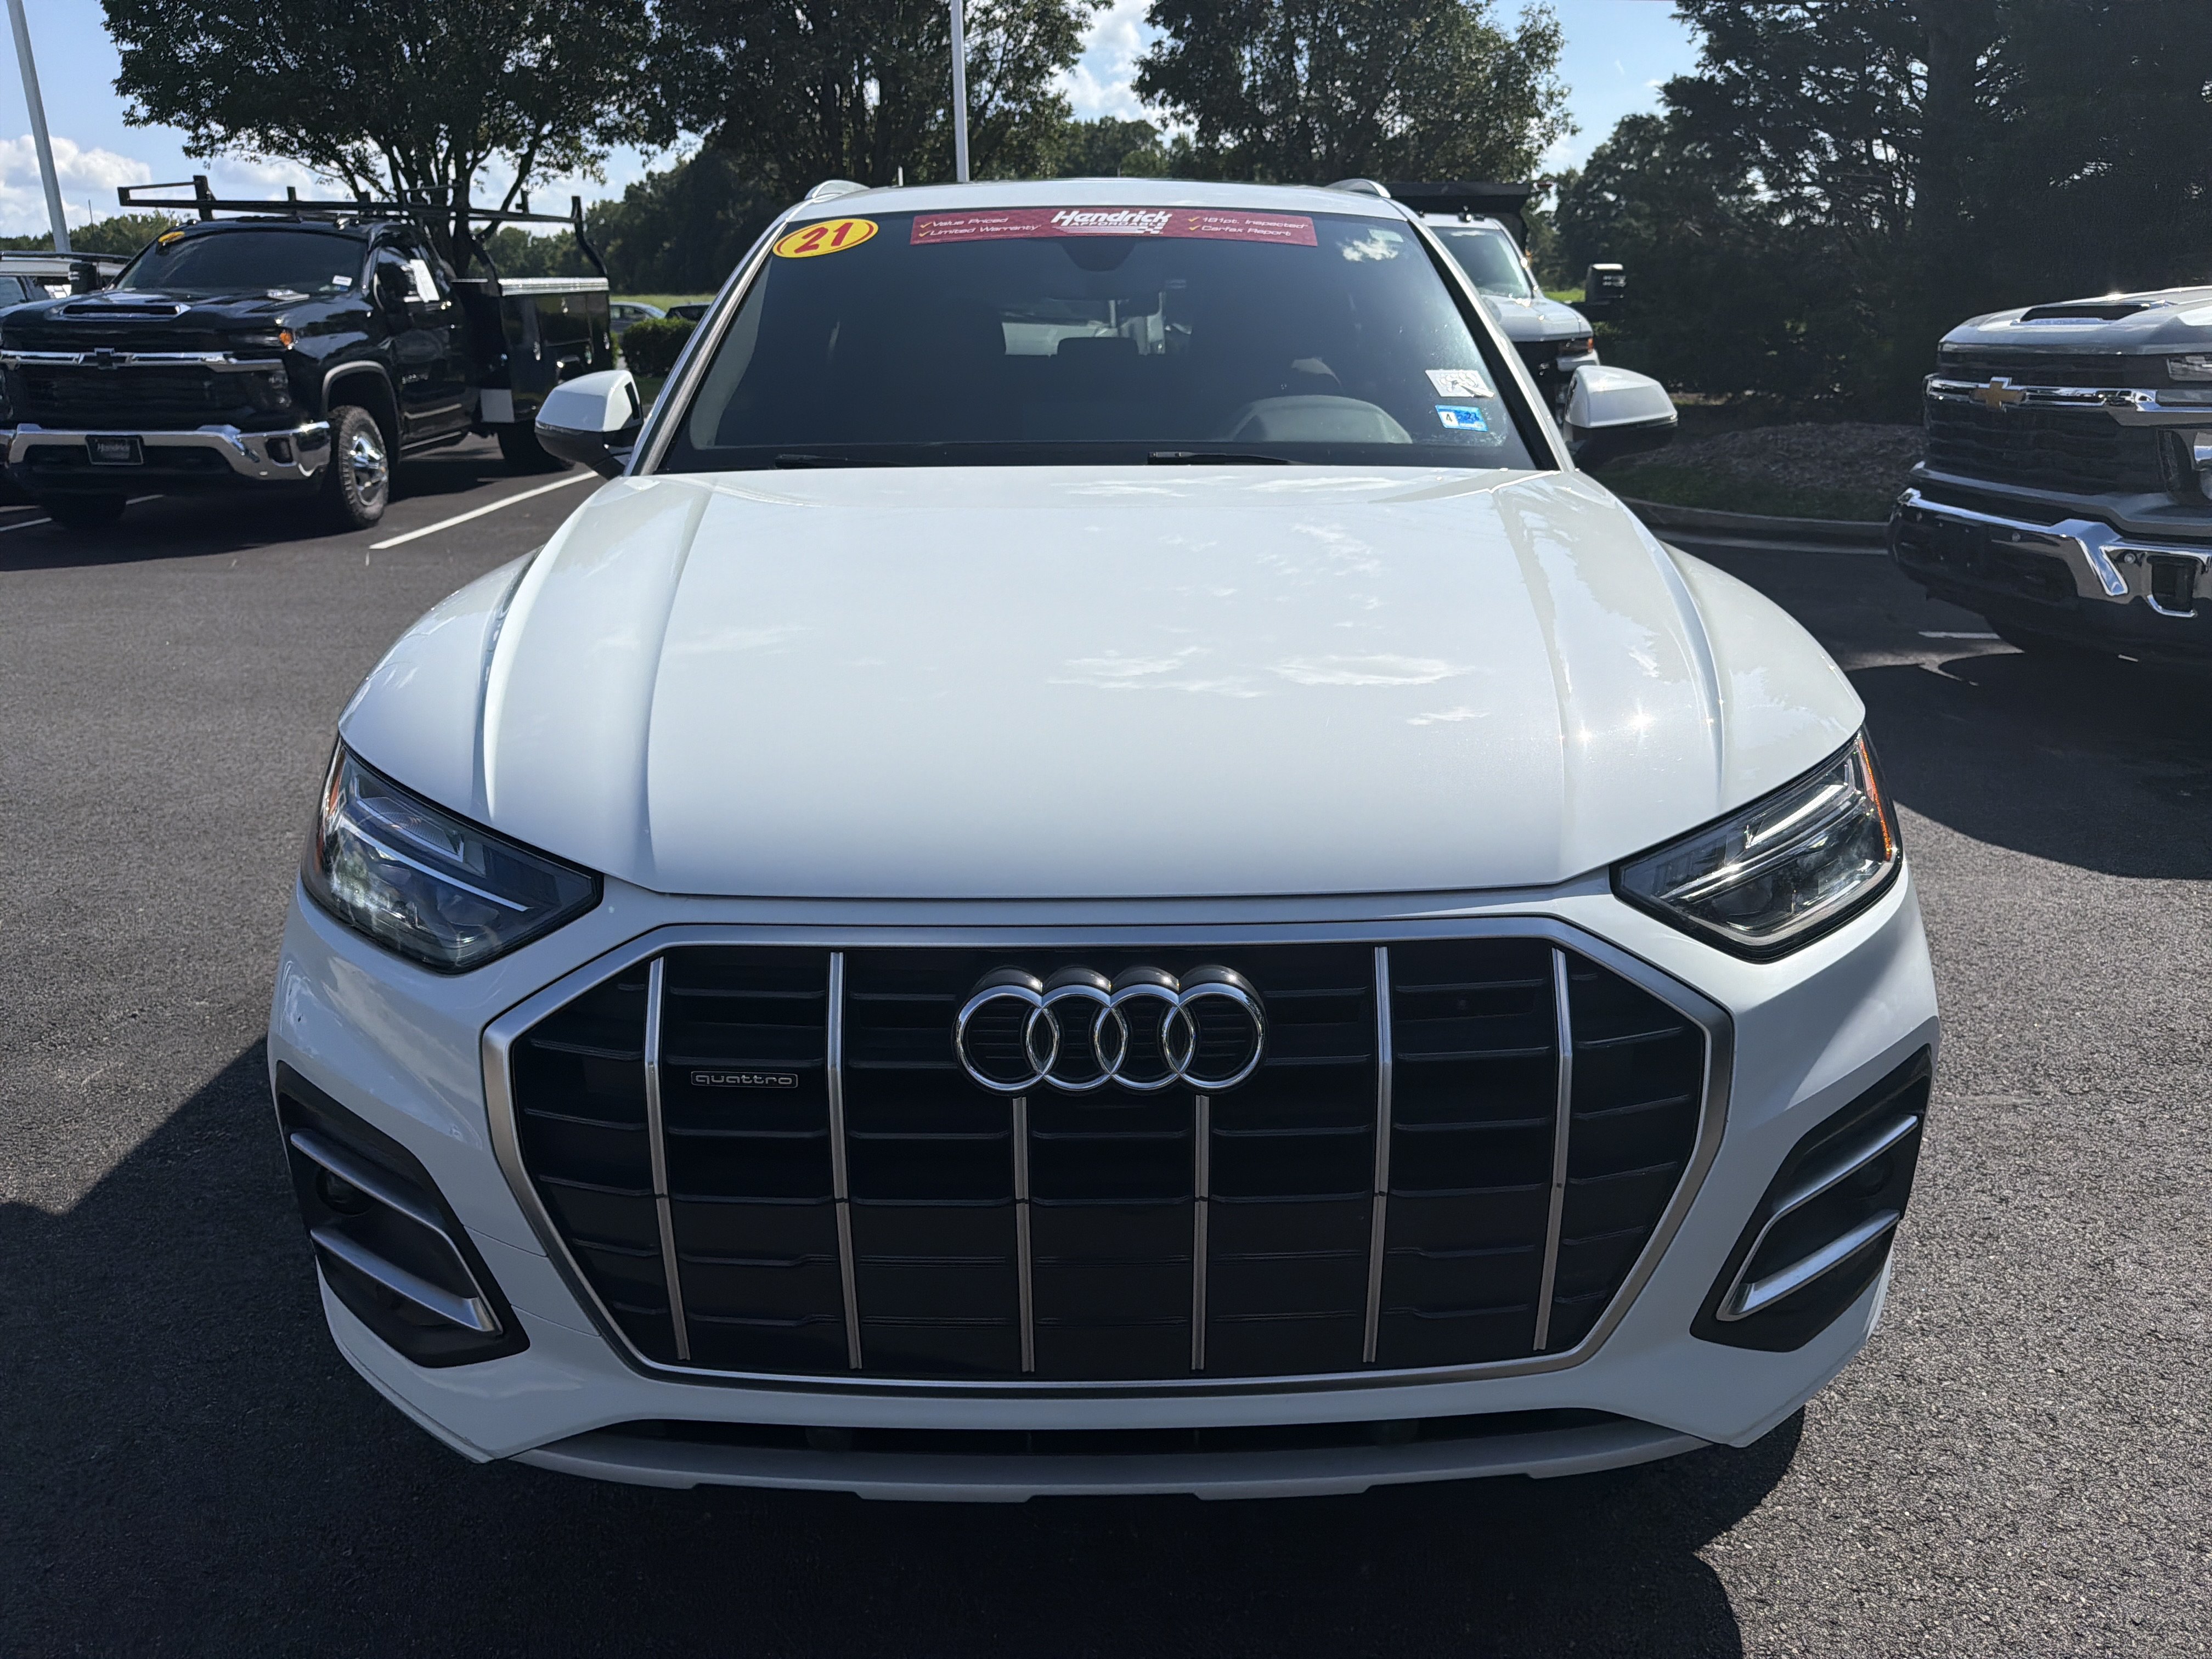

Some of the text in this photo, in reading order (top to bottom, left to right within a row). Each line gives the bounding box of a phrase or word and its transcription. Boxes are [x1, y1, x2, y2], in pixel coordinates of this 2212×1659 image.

[1050, 210, 1173, 227] Hendrick
[930, 227, 977, 236] Limited
[1247, 228, 1291, 236] Report
[794, 222, 854, 253] 21
[1446, 413, 1453, 422] 4
[695, 1075, 792, 1085] quattro
